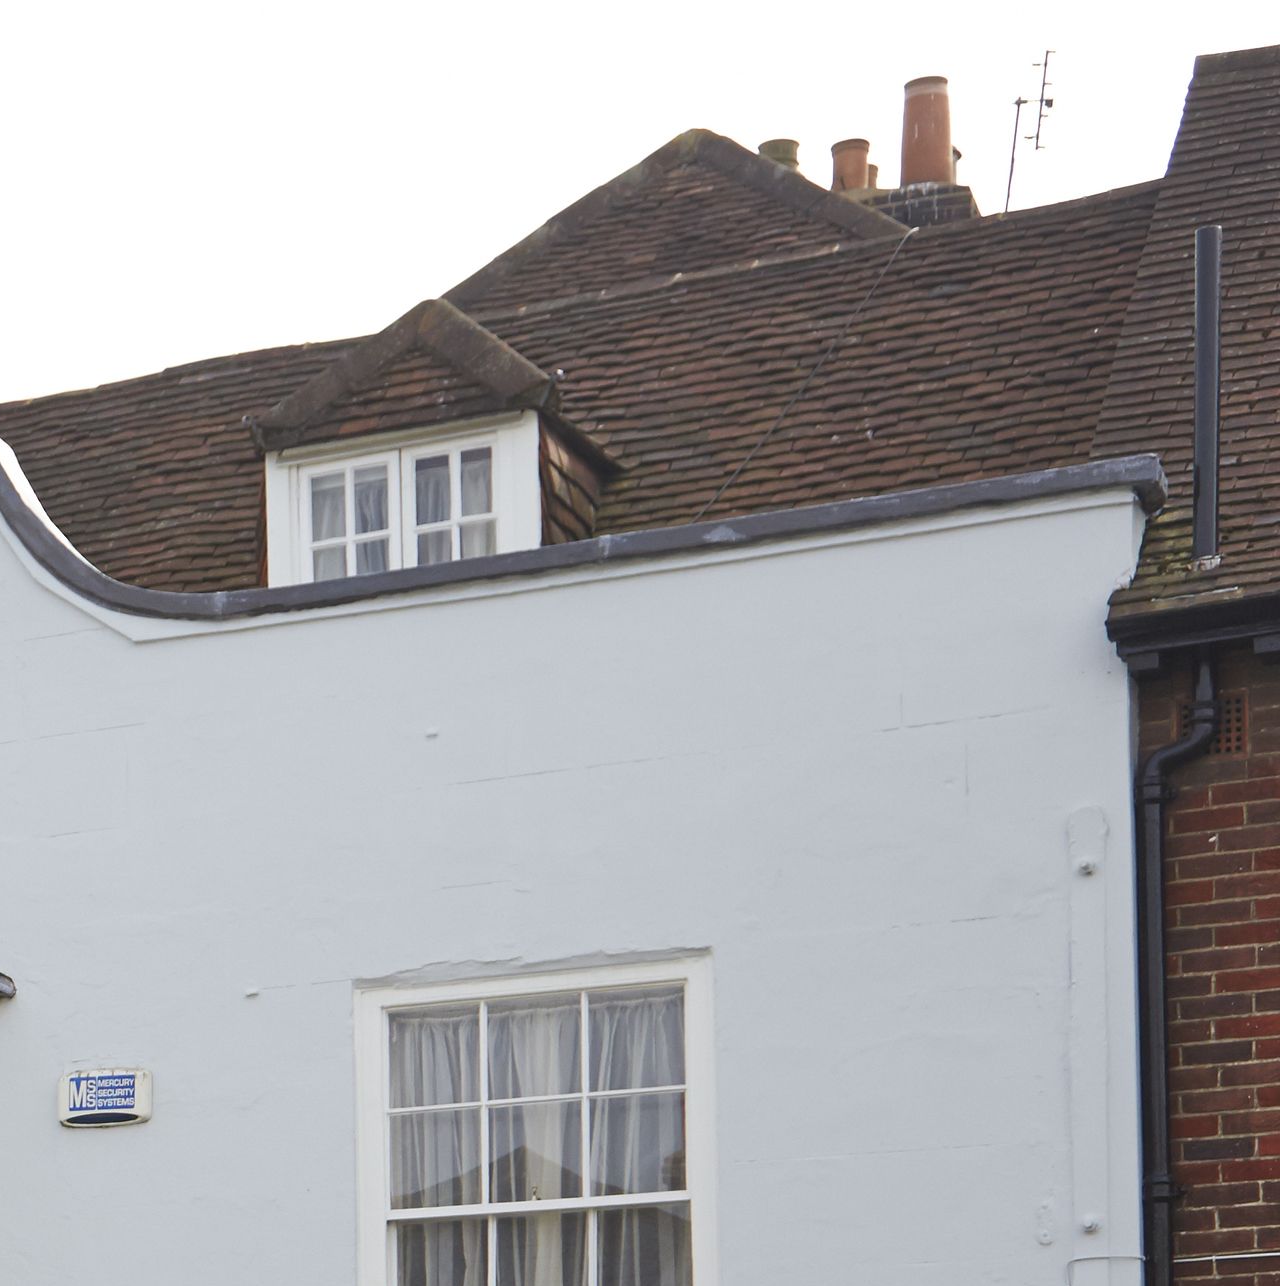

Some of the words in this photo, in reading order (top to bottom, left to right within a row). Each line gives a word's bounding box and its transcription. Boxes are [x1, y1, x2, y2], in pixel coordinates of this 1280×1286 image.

[98, 1078, 135, 1087] MERCURY
[98, 1088, 135, 1097] SECURITY
[97, 1097, 135, 1107] SYSTEMS
